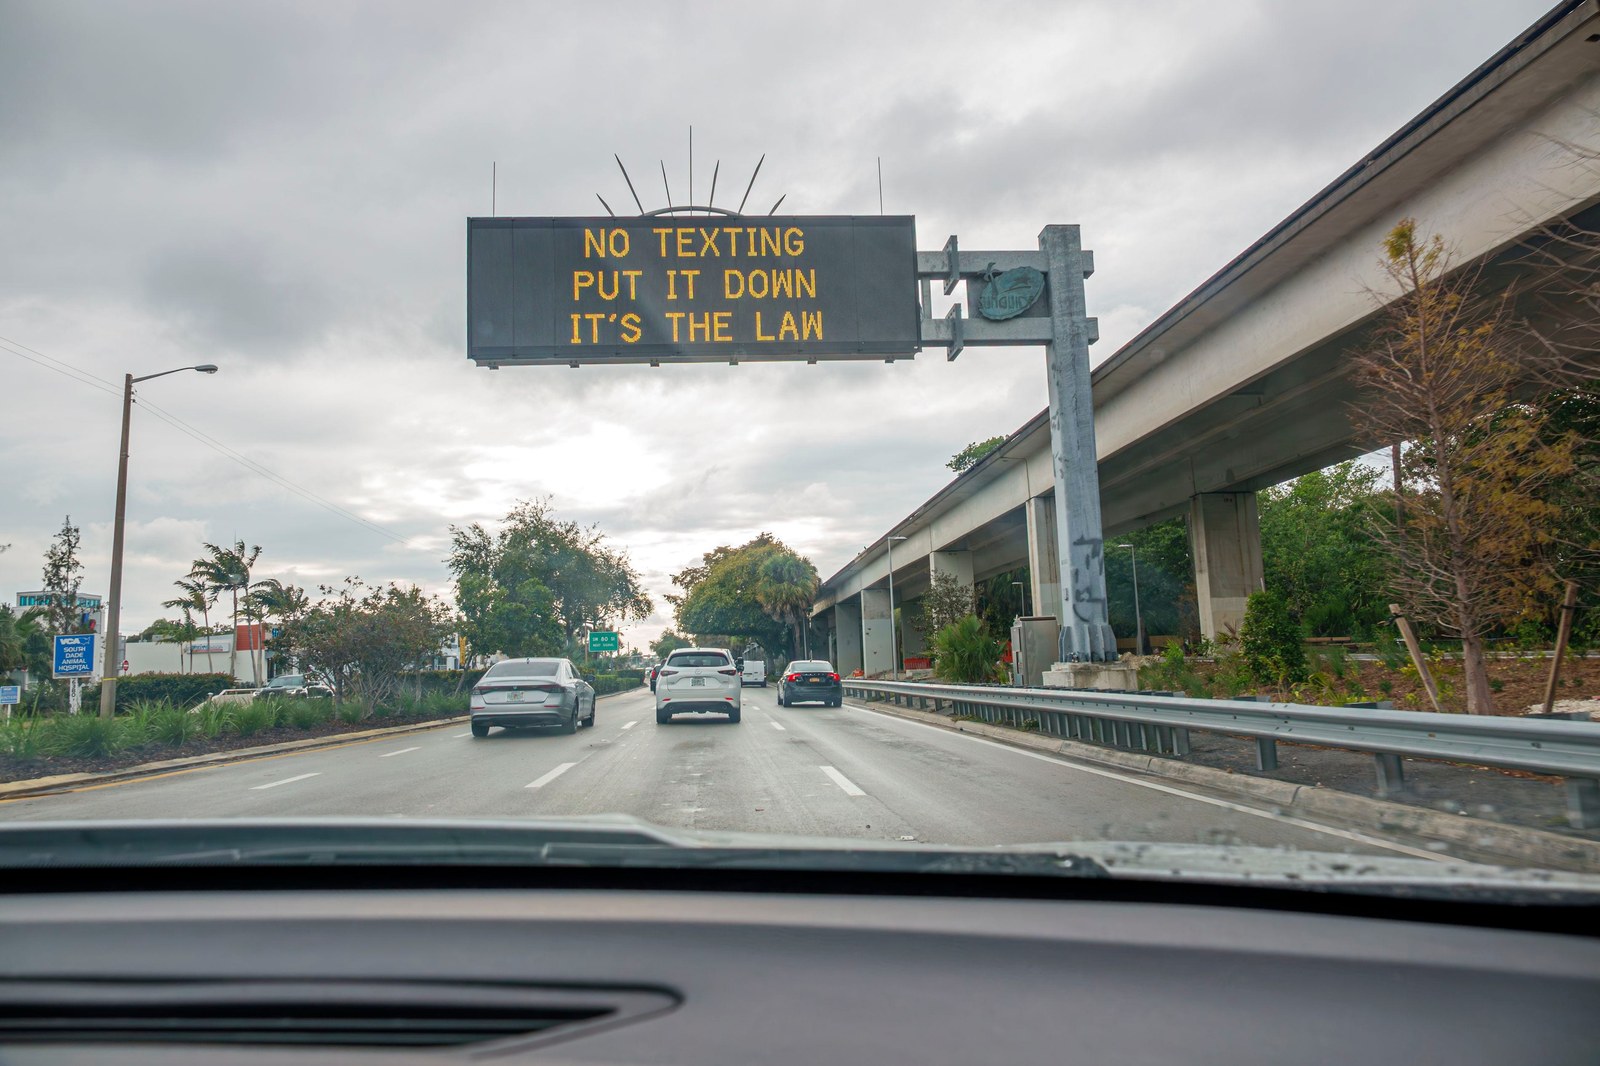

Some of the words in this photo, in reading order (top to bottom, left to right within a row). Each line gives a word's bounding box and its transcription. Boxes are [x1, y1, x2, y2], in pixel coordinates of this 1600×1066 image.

[585, 228, 630, 258] NO
[653, 227, 805, 258] TEXTING
[573, 270, 643, 301] PUT
[667, 270, 701, 301] IT
[724, 269, 817, 300] DOWN
[570, 313, 642, 344] IT'S
[665, 312, 733, 343] THE
[756, 311, 824, 342] LAW
